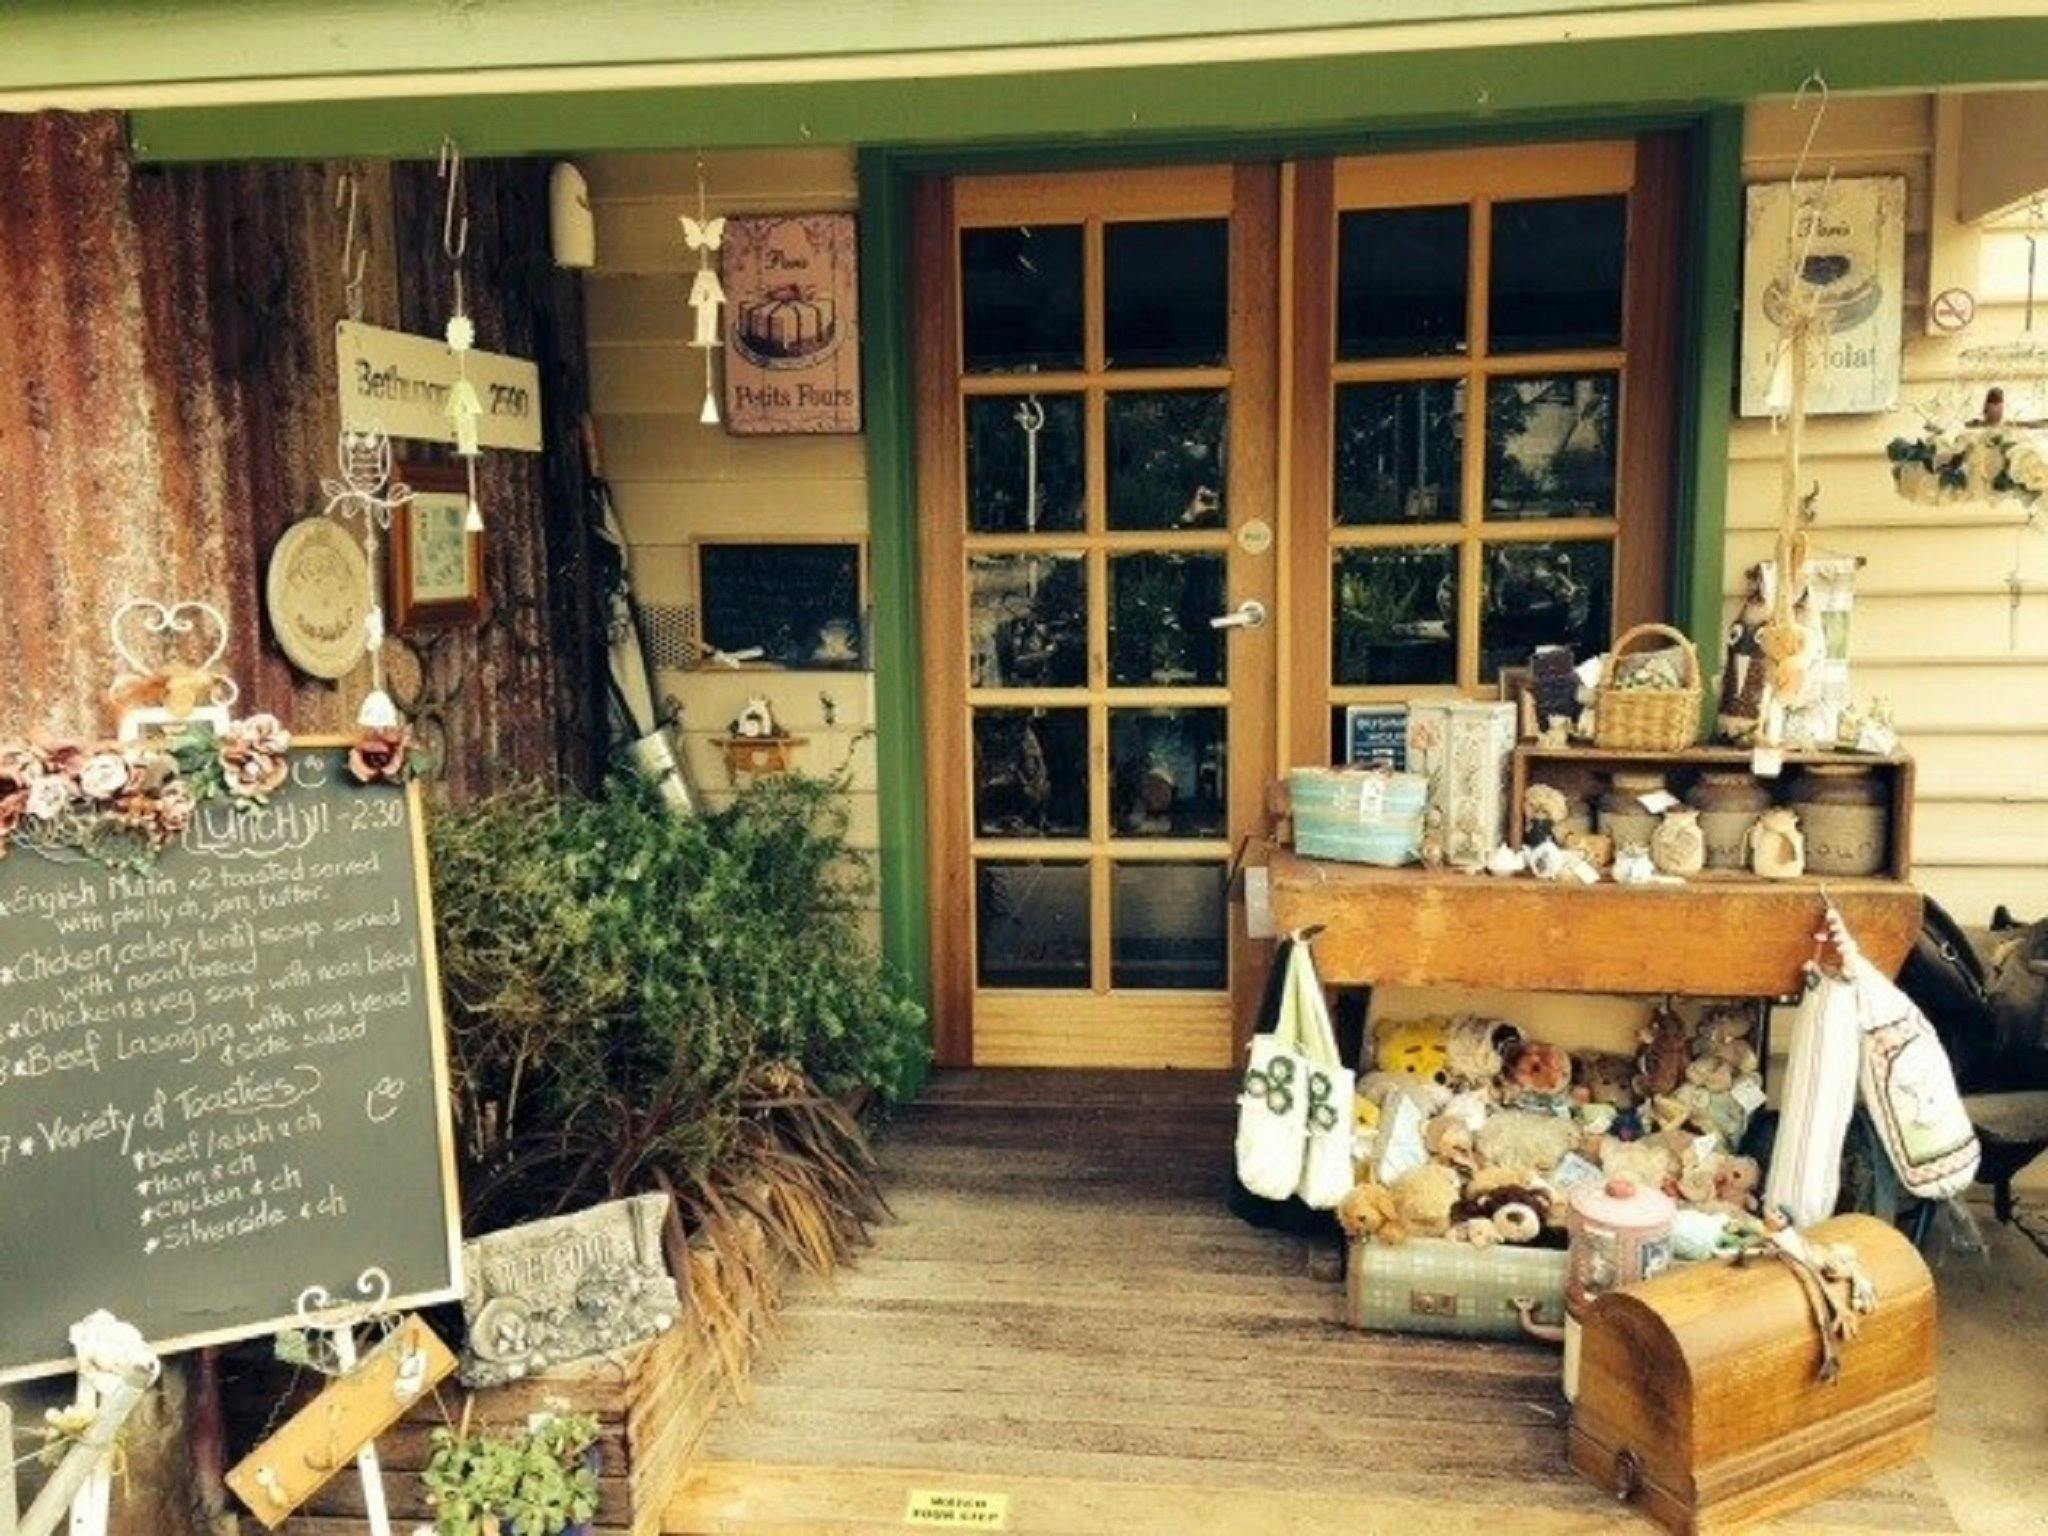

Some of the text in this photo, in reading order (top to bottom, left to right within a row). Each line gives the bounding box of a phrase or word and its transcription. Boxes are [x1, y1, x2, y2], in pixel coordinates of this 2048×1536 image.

[734, 382, 854, 410] Petits Fours
[220, 856, 305, 887] toasted
[309, 850, 379, 878] served
[54, 911, 104, 936] with
[333, 898, 400, 932] served
[58, 973, 113, 1002] with
[188, 950, 257, 979] bread
[26, 1029, 101, 1076] Beef
[246, 1003, 297, 1035] with
[36, 1102, 136, 1156] Variety
[143, 1086, 167, 1130] of
